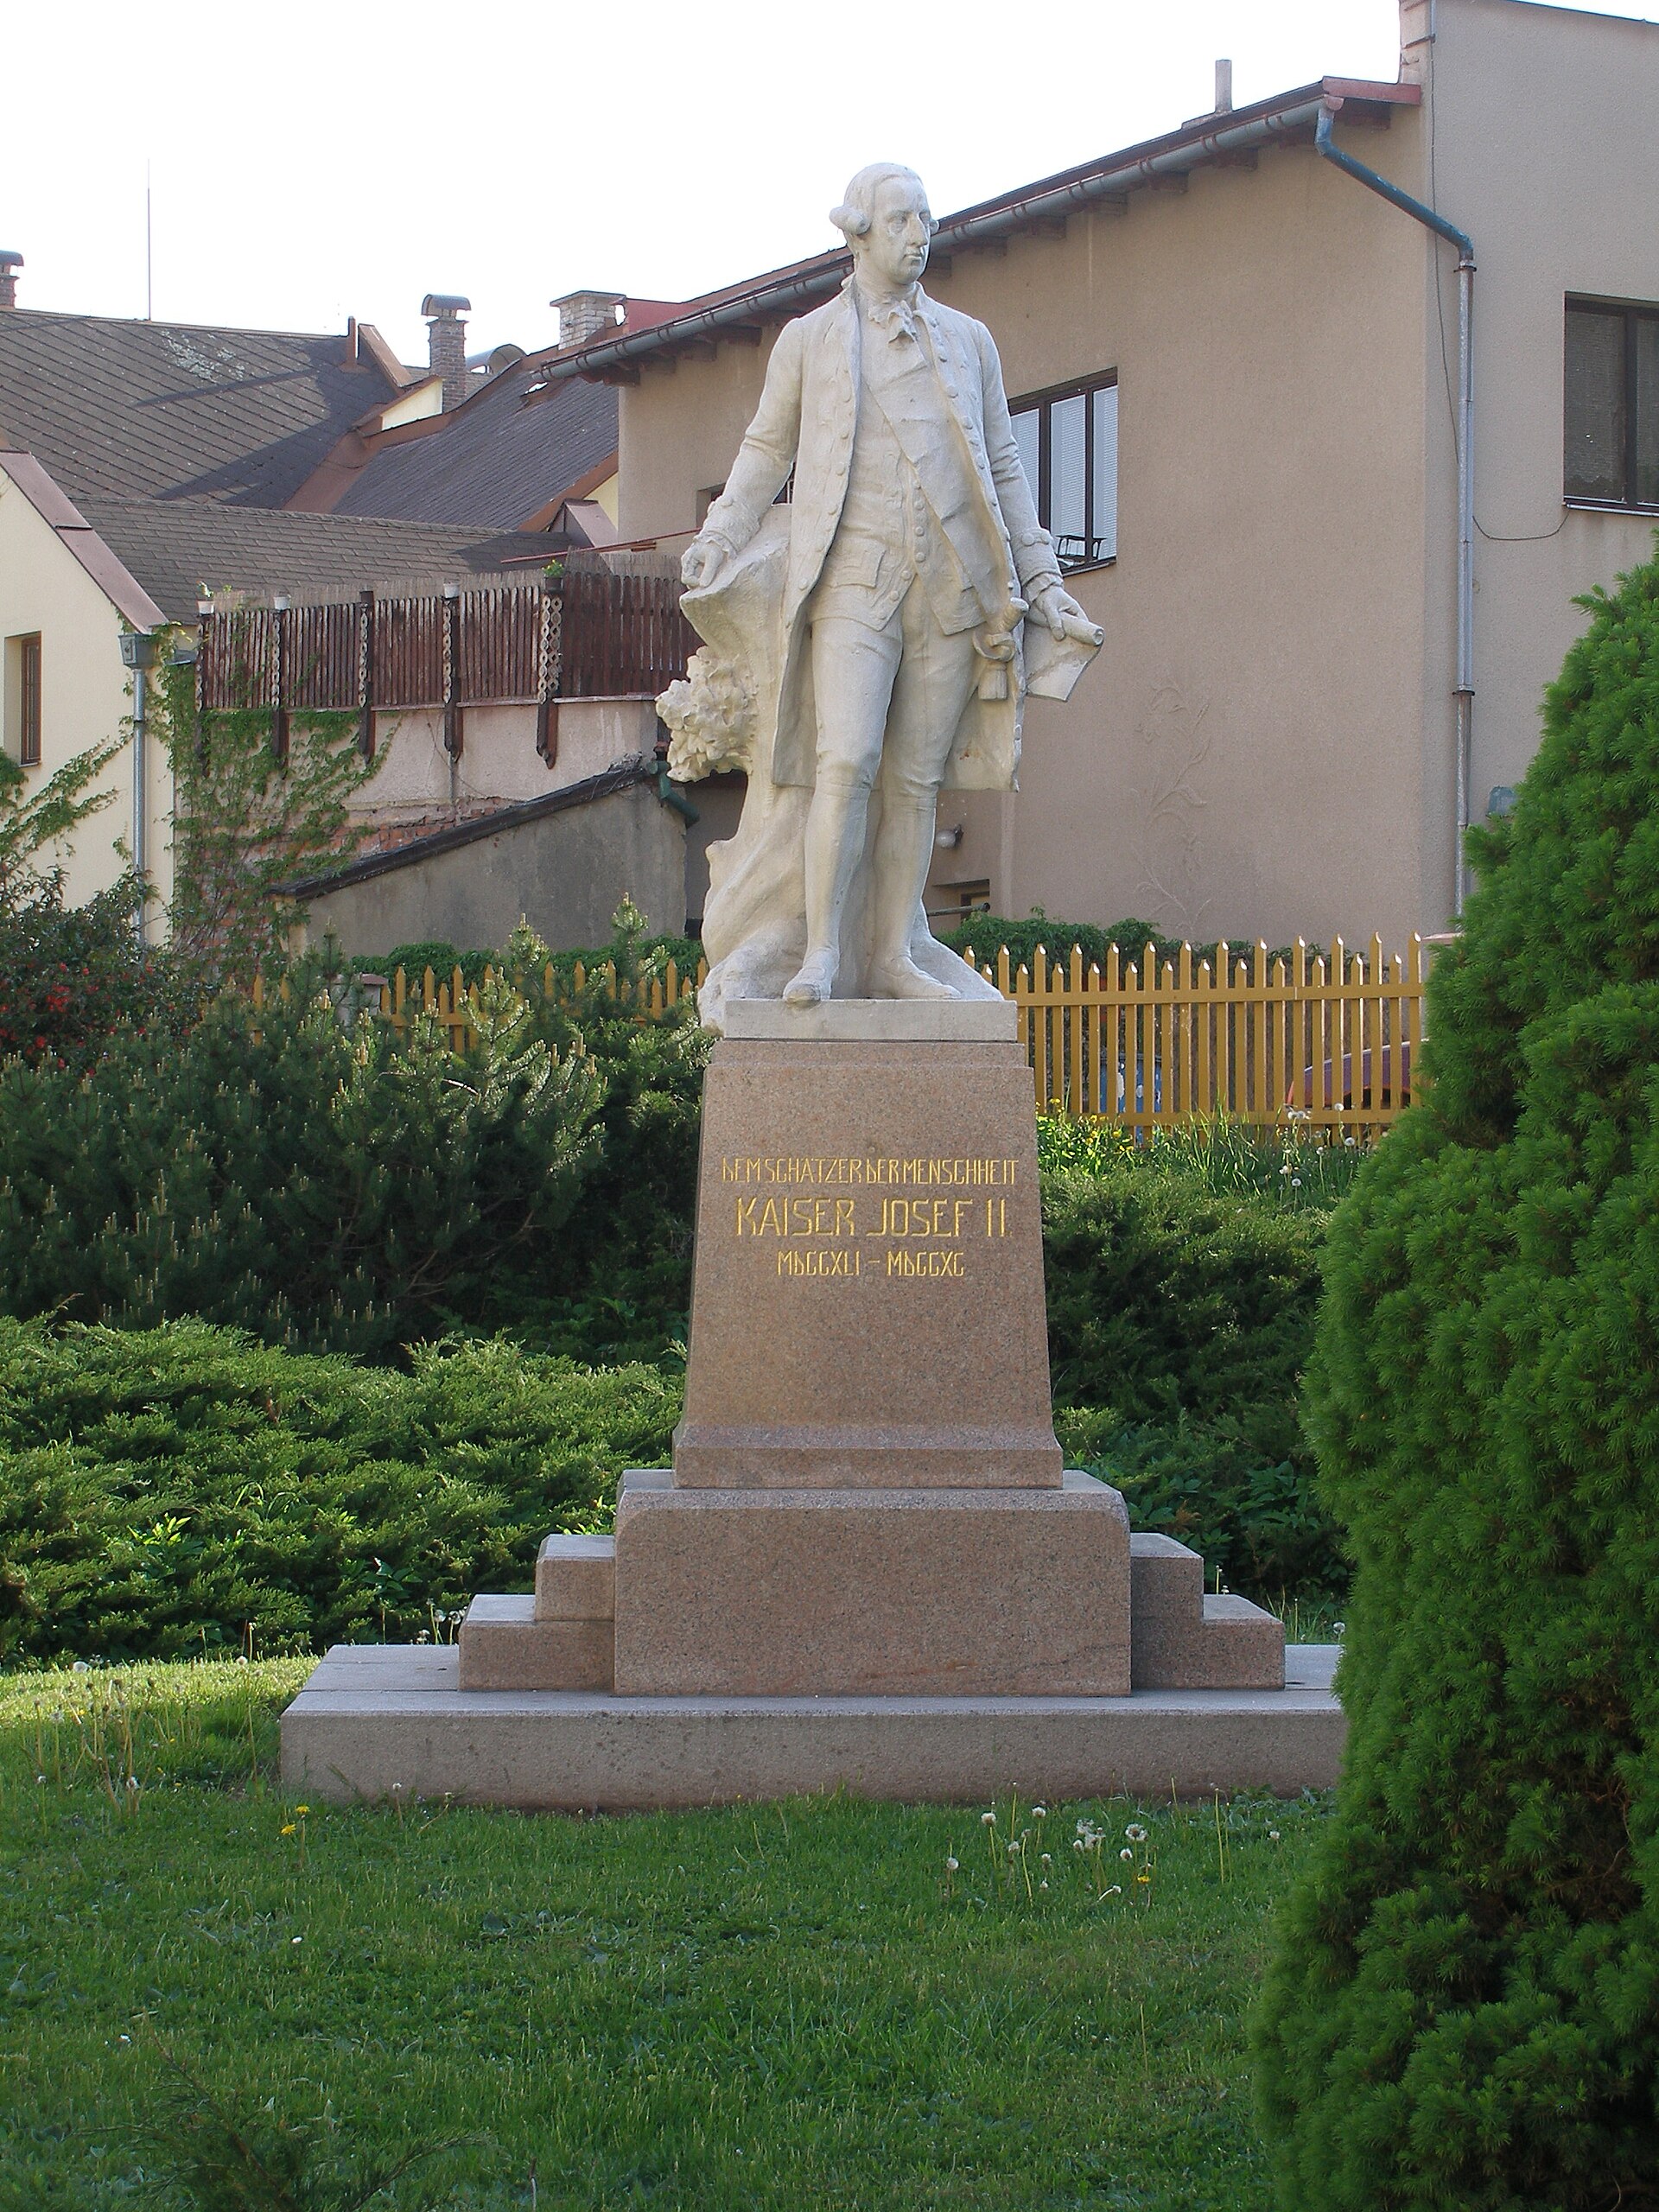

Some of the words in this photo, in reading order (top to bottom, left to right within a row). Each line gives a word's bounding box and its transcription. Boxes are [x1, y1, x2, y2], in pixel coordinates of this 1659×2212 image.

[722, 1157, 761, 1183] DEM
[866, 1158, 899, 1184] DER
[903, 1158, 1020, 1185] MENSCHHEIT
[735, 1198, 856, 1236] KAISER
[866, 1198, 974, 1237] JOSEF
[777, 1250, 861, 1276] MDCCXLI
[886, 1250, 964, 1277] MDCCXC
